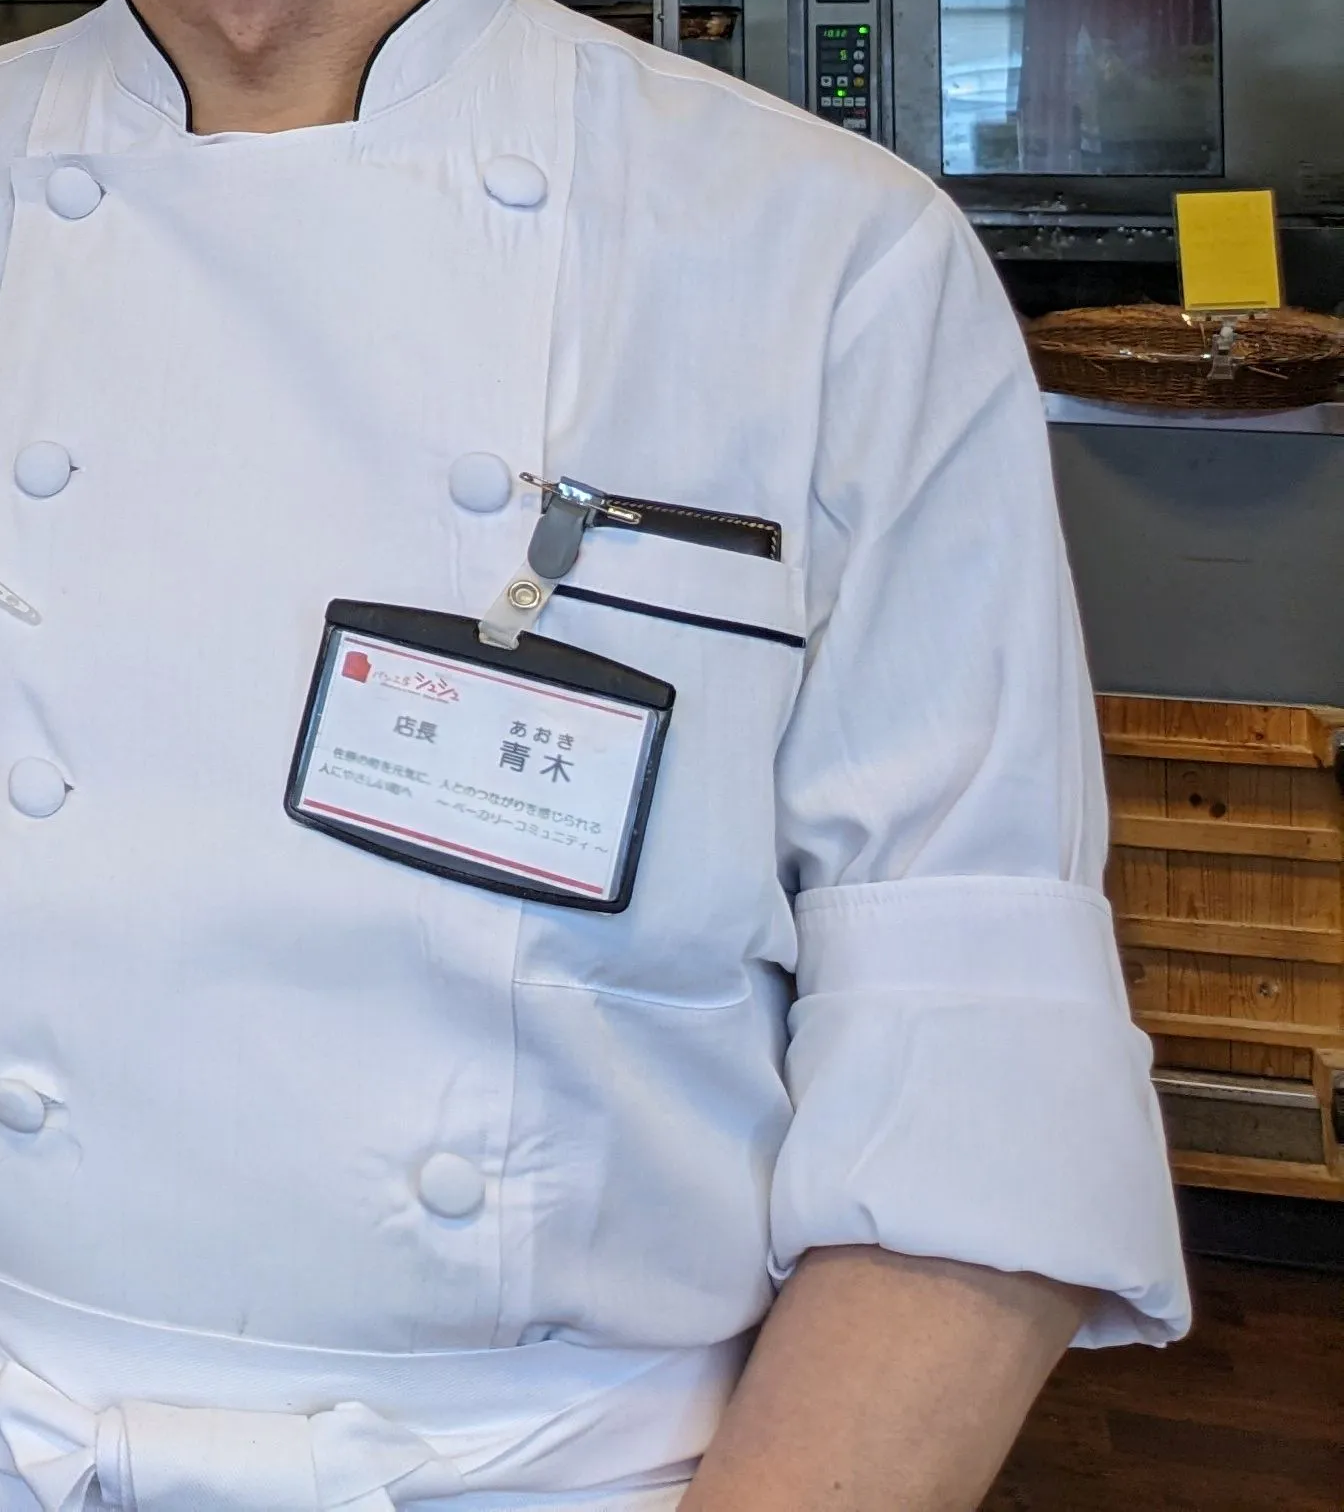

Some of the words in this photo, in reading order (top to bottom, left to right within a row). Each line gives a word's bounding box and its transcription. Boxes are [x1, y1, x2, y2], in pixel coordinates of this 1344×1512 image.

[392, 715, 439, 744] 店長
[509, 720, 575, 751] あおき
[499, 740, 575, 784] 青木
[438, 778, 603, 835] 人とのつながりを感じられる
